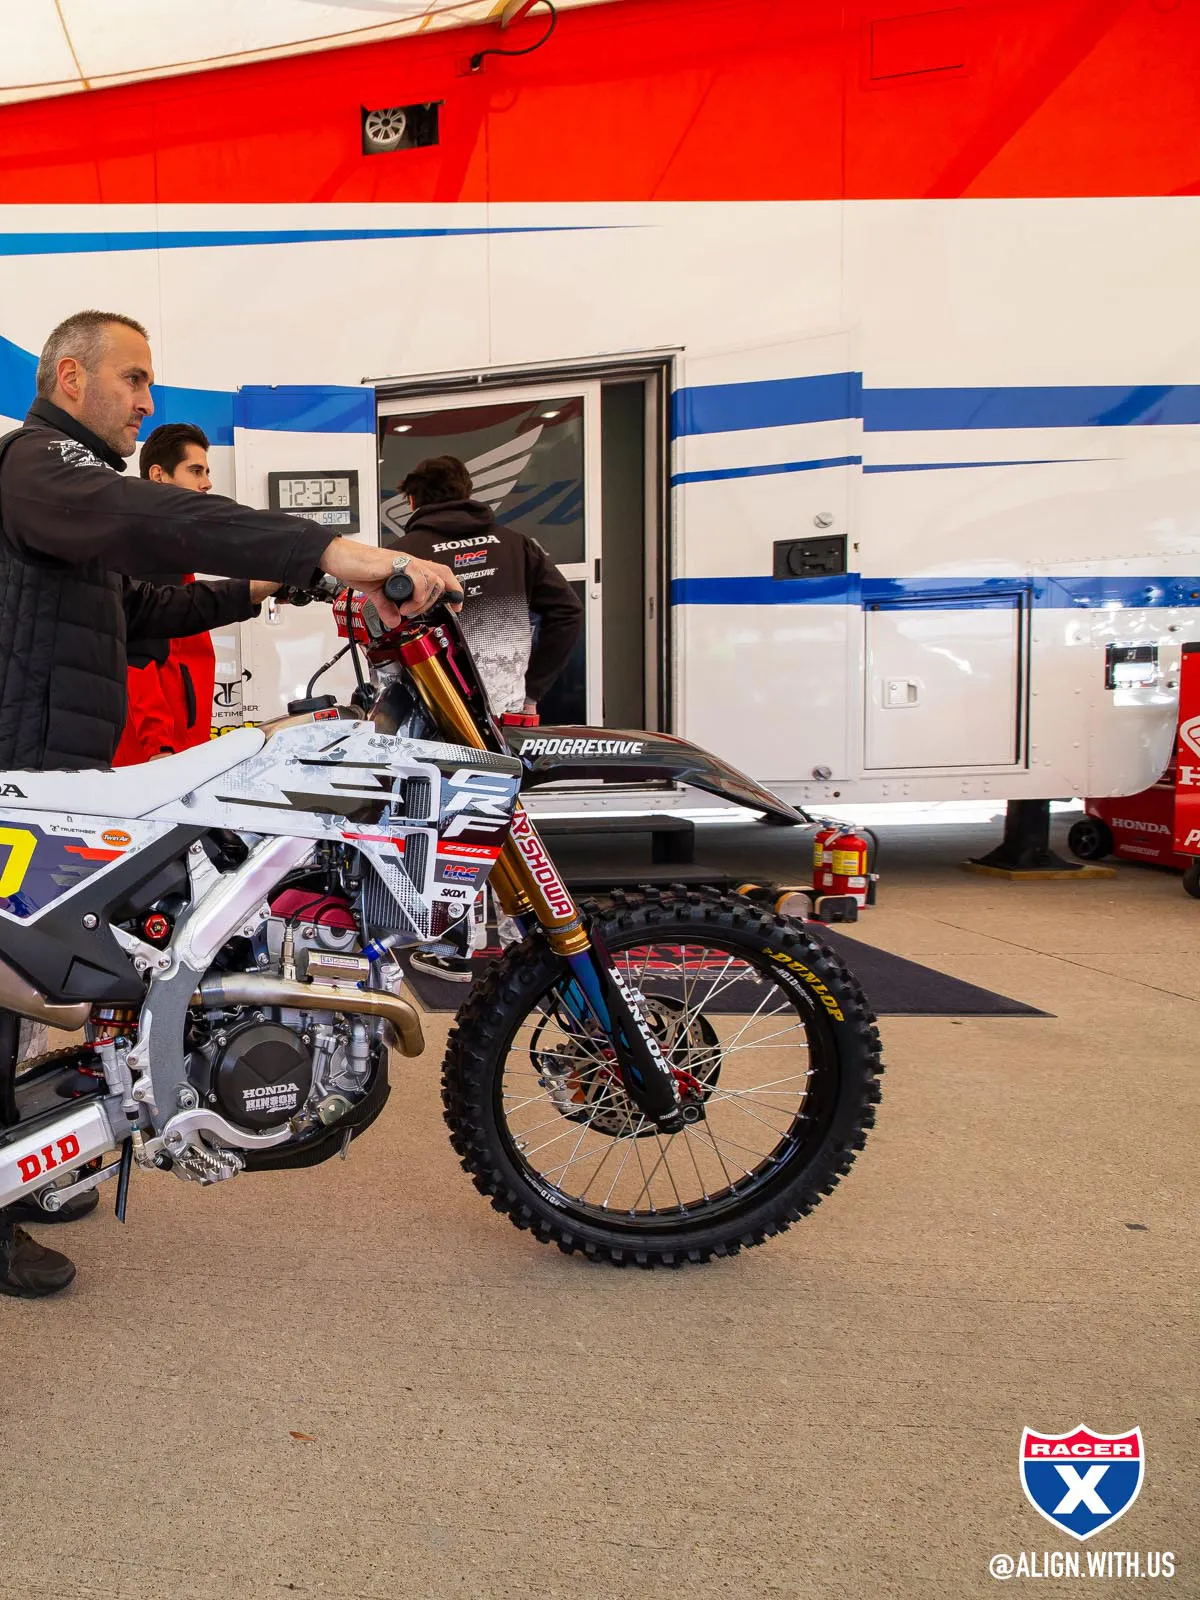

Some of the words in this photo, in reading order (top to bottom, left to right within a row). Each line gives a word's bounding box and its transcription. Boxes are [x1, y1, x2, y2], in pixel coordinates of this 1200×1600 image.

[432, 535, 500, 552] HONDA
[454, 550, 488, 567] HRC
[455, 567, 497, 581] OGRESSIVE
[334, 600, 361, 613] RENAL
[336, 615, 364, 629] RENAL
[519, 738, 643, 756] PROGRESSIVE
[1111, 817, 1171, 835] HONDA
[443, 844, 492, 855] 250R
[443, 864, 480, 880] HRC
[518, 837, 575, 919] SHOWA
[440, 888, 467, 899] SKDA
[770, 952, 845, 1022] DUNLOP
[608, 966, 670, 1075] DUNLOP
[242, 1082, 300, 1099] HONDA
